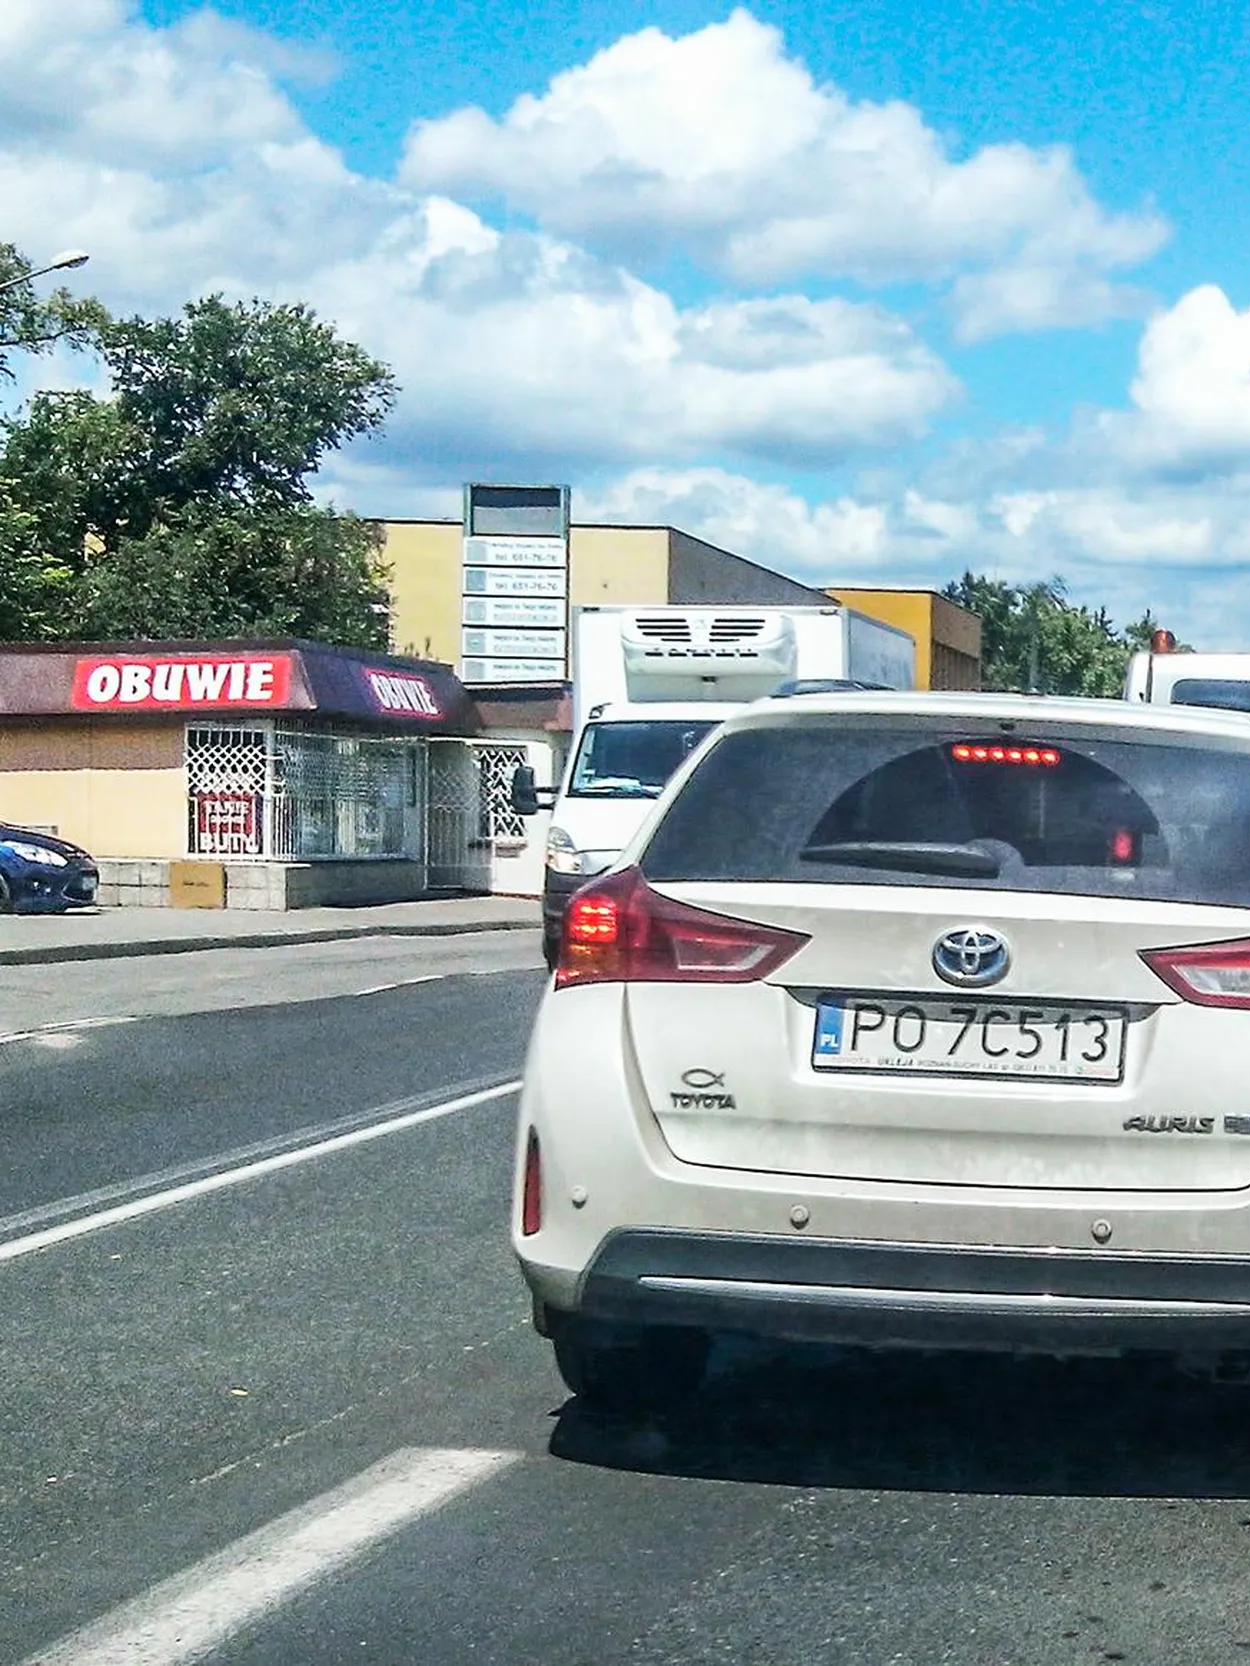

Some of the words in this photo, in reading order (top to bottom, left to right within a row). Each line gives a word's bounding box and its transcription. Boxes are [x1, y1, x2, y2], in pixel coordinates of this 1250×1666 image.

[87, 662, 274, 702] OBUWIE
[370, 674, 438, 714] OBUWIE
[820, 1033, 838, 1047] PL
[851, 1003, 926, 1053] PO
[947, 1006, 1110, 1063] 7C513
[670, 1092, 737, 1110] TOYOTA
[1123, 1116, 1215, 1134] AURIS
